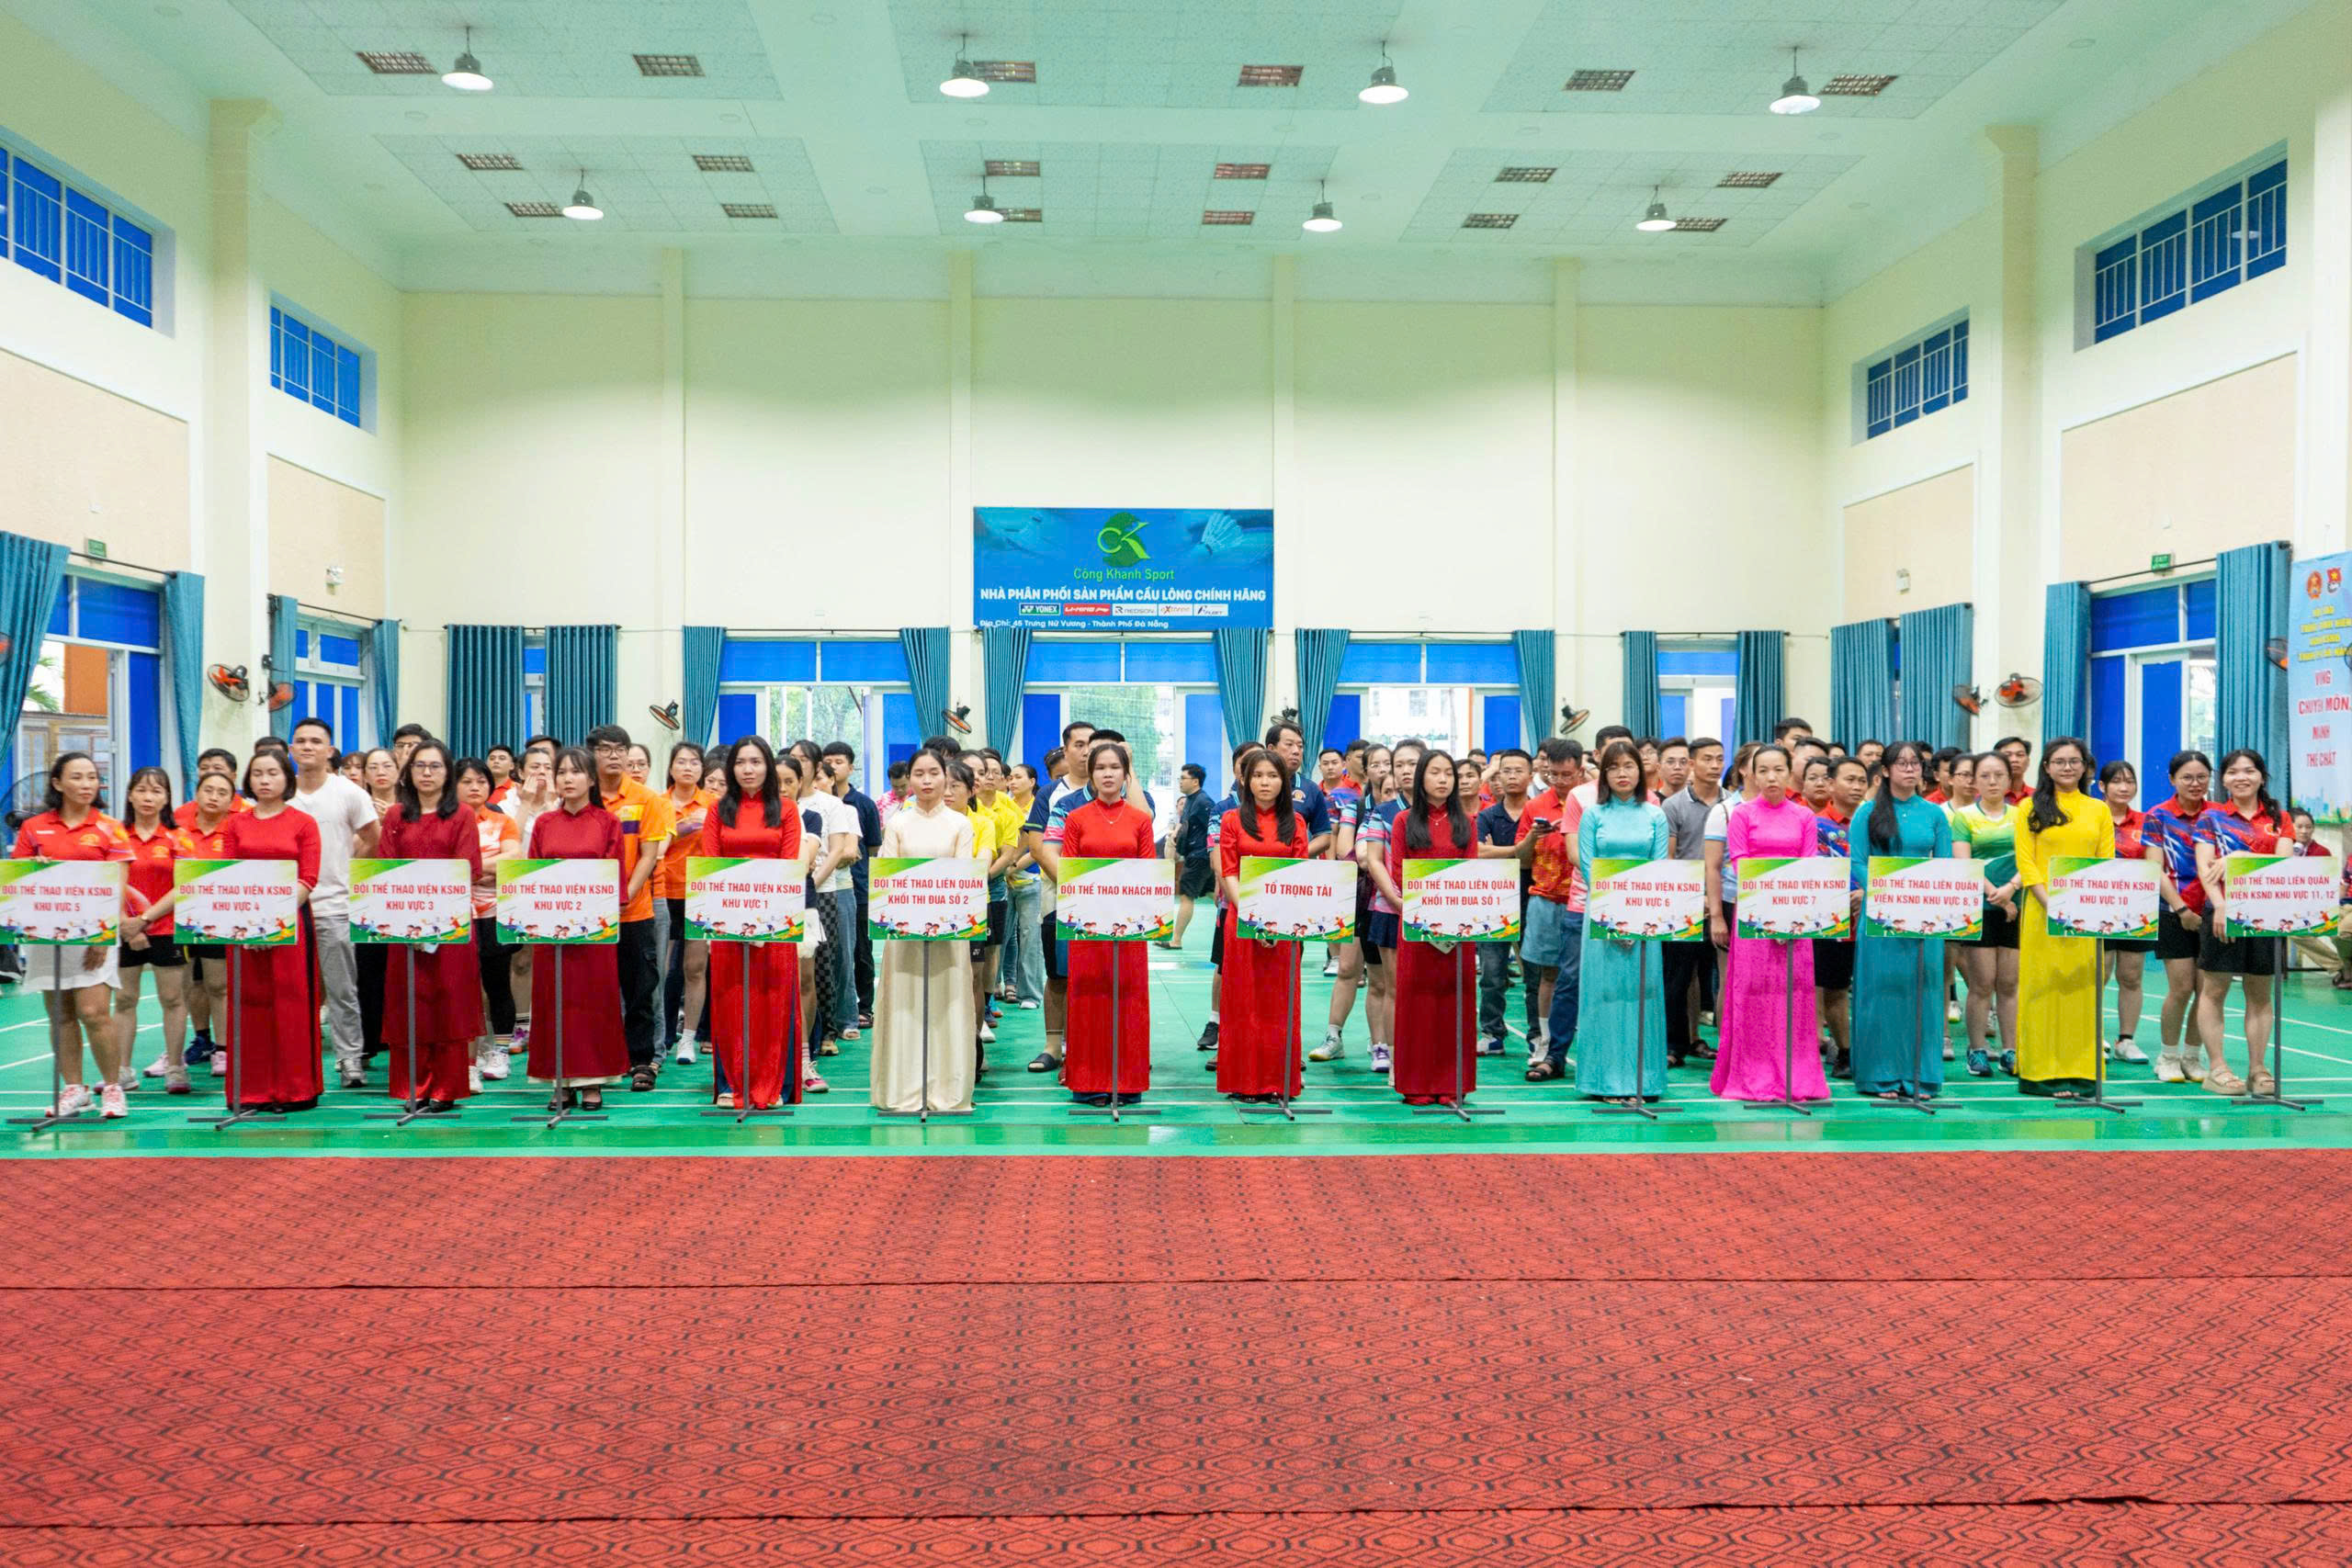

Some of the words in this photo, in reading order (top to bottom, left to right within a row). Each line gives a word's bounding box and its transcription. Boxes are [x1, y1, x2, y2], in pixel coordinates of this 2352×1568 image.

[1073, 568, 1103, 582] Công
[1106, 568, 1141, 580] Khanh
[1145, 568, 1175, 581] Sport
[980, 585, 1005, 600] NHÀ
[1008, 586, 1040, 600] PHÂN
[1043, 584, 1070, 601] PHỐI
[1162, 587, 1193, 602] LÔNG
[1194, 586, 1232, 602] CHÍNH
[1035, 605, 1057, 614] YONEX
[911, 879, 933, 889] THAO
[1443, 880, 1466, 890] THAO
[1778, 880, 1800, 890] THAO
[1823, 880, 1847, 890] KSND
[1907, 880, 1930, 890] THAO
[2087, 880, 2109, 889] THAO
[2132, 882, 2155, 891] KSND
[2266, 876, 2286, 886] THAO
[39, 886, 62, 896] THAO
[87, 887, 113, 897] KSND
[218, 886, 241, 896] THAO
[266, 886, 293, 896] KSND
[391, 885, 414, 894] THAO
[441, 885, 467, 895] KSND
[539, 885, 563, 894] THAO
[588, 885, 615, 895] KSND
[728, 883, 751, 893] THAO
[775, 884, 802, 894] KSND
[1097, 886, 1120, 896] THAO
[1631, 882, 1653, 891] THAO
[1677, 883, 1701, 892] KSND
[911, 895, 926, 905] THI
[2080, 896, 2098, 905] KHU
[2119, 897, 2129, 906] 10
[2251, 891, 2273, 900] KSND
[2275, 891, 2291, 900] KHU
[2312, 891, 2324, 901] 11,
[2325, 891, 2335, 900] 12
[212, 902, 231, 911] KHU
[386, 900, 405, 911] KHU
[535, 900, 553, 911] KHU
[722, 899, 741, 908] KHU
[1446, 897, 1460, 906] THI
[1624, 898, 1643, 908] KHU
[1771, 897, 1789, 906] KHU
[1896, 896, 1920, 905] KSND
[1922, 897, 1941, 906] KHU
[1962, 897, 1972, 908] 8,
[33, 902, 52, 912] KHU
